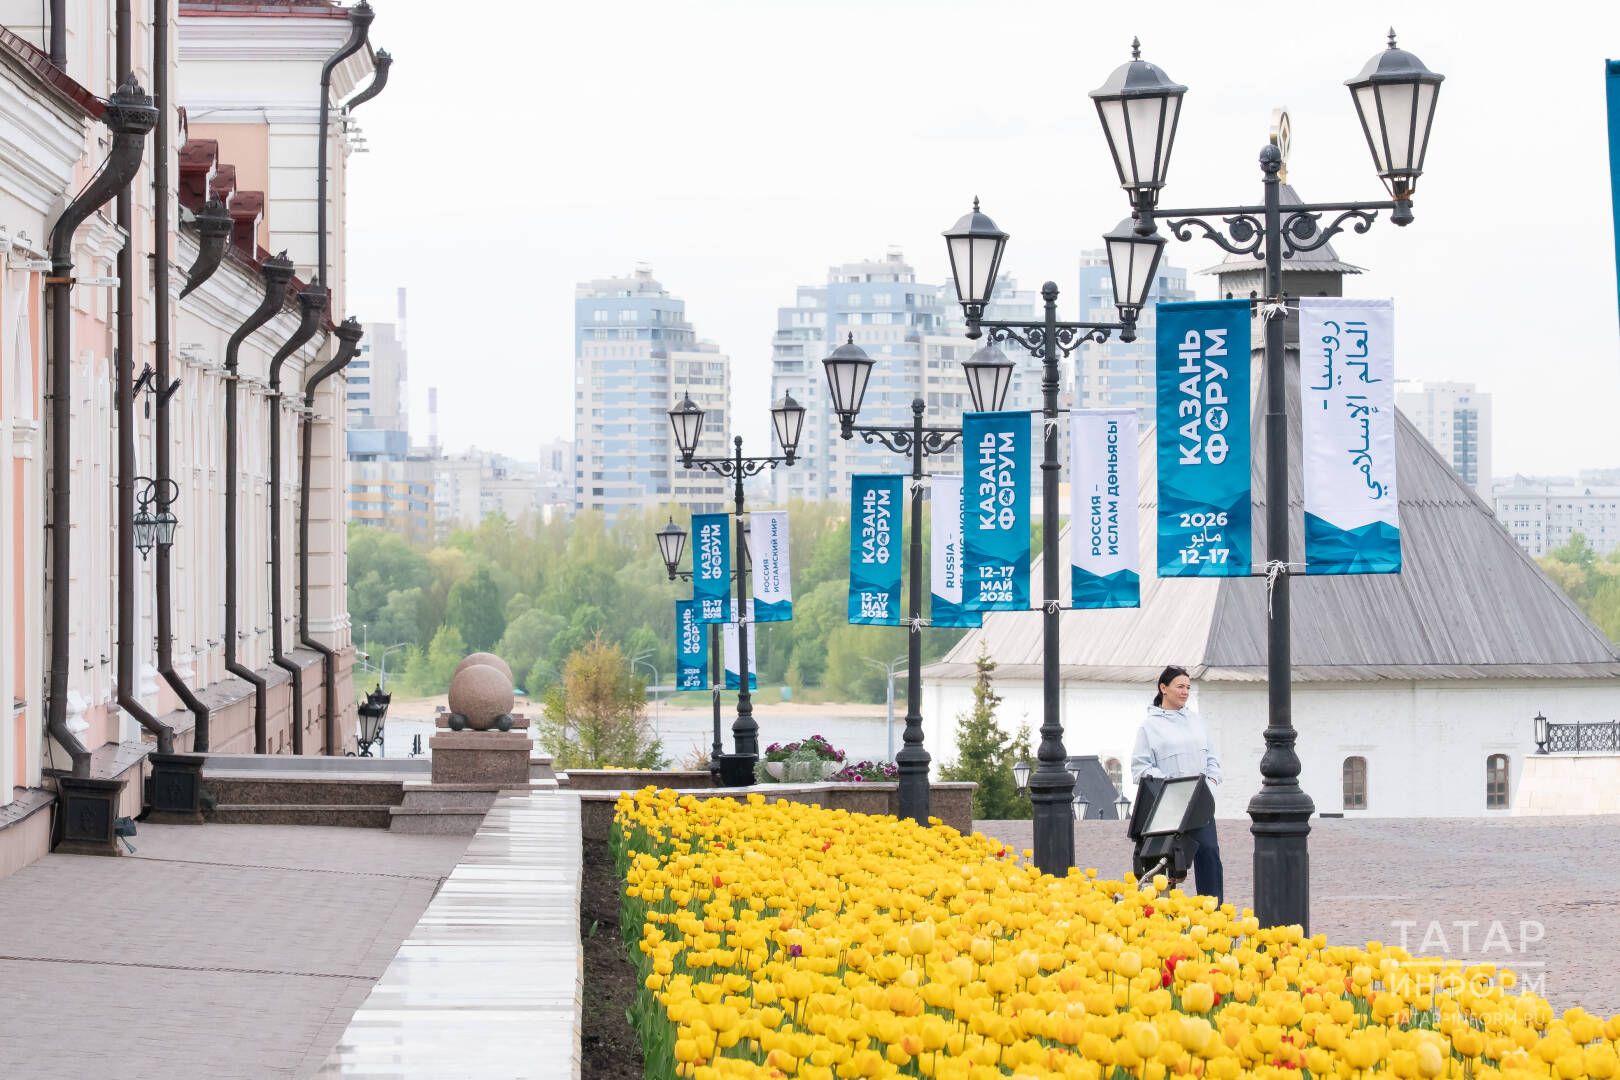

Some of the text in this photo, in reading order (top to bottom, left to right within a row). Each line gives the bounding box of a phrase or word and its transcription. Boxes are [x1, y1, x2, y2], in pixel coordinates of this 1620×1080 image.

[1310, 320, 1342, 391] روسيا
[1179, 330, 1201, 464] КАЗАНЬ
[1205, 329, 1228, 464] ФОРУМ
[1345, 321, 1388, 500] العالم الإسلامي
[980, 433, 996, 529] КАЗАНЬ
[998, 432, 1015, 529] ФОРУМ
[1108, 421, 1120, 555] ИСЛАМ ДӨНЬЯСЫ
[863, 489, 876, 563] КАЗАНЬ
[876, 489, 891, 564] ФОРУМ
[1091, 495, 1101, 556] РОССИЯ
[1180, 512, 1227, 528] 2026
[1186, 526, 1222, 549] مايو
[702, 524, 711, 579] КАЗАНЬ
[712, 524, 722, 579] ФОРУМ
[946, 543, 954, 588] RUSSIA
[862, 601, 888, 611] MAY
[980, 590, 1012, 601] 2026
[981, 578, 1012, 591] МАЙ
[683, 608, 692, 653] КАЗАНЬ
[692, 609, 700, 653] ФОР
[861, 610, 888, 618] 2026
